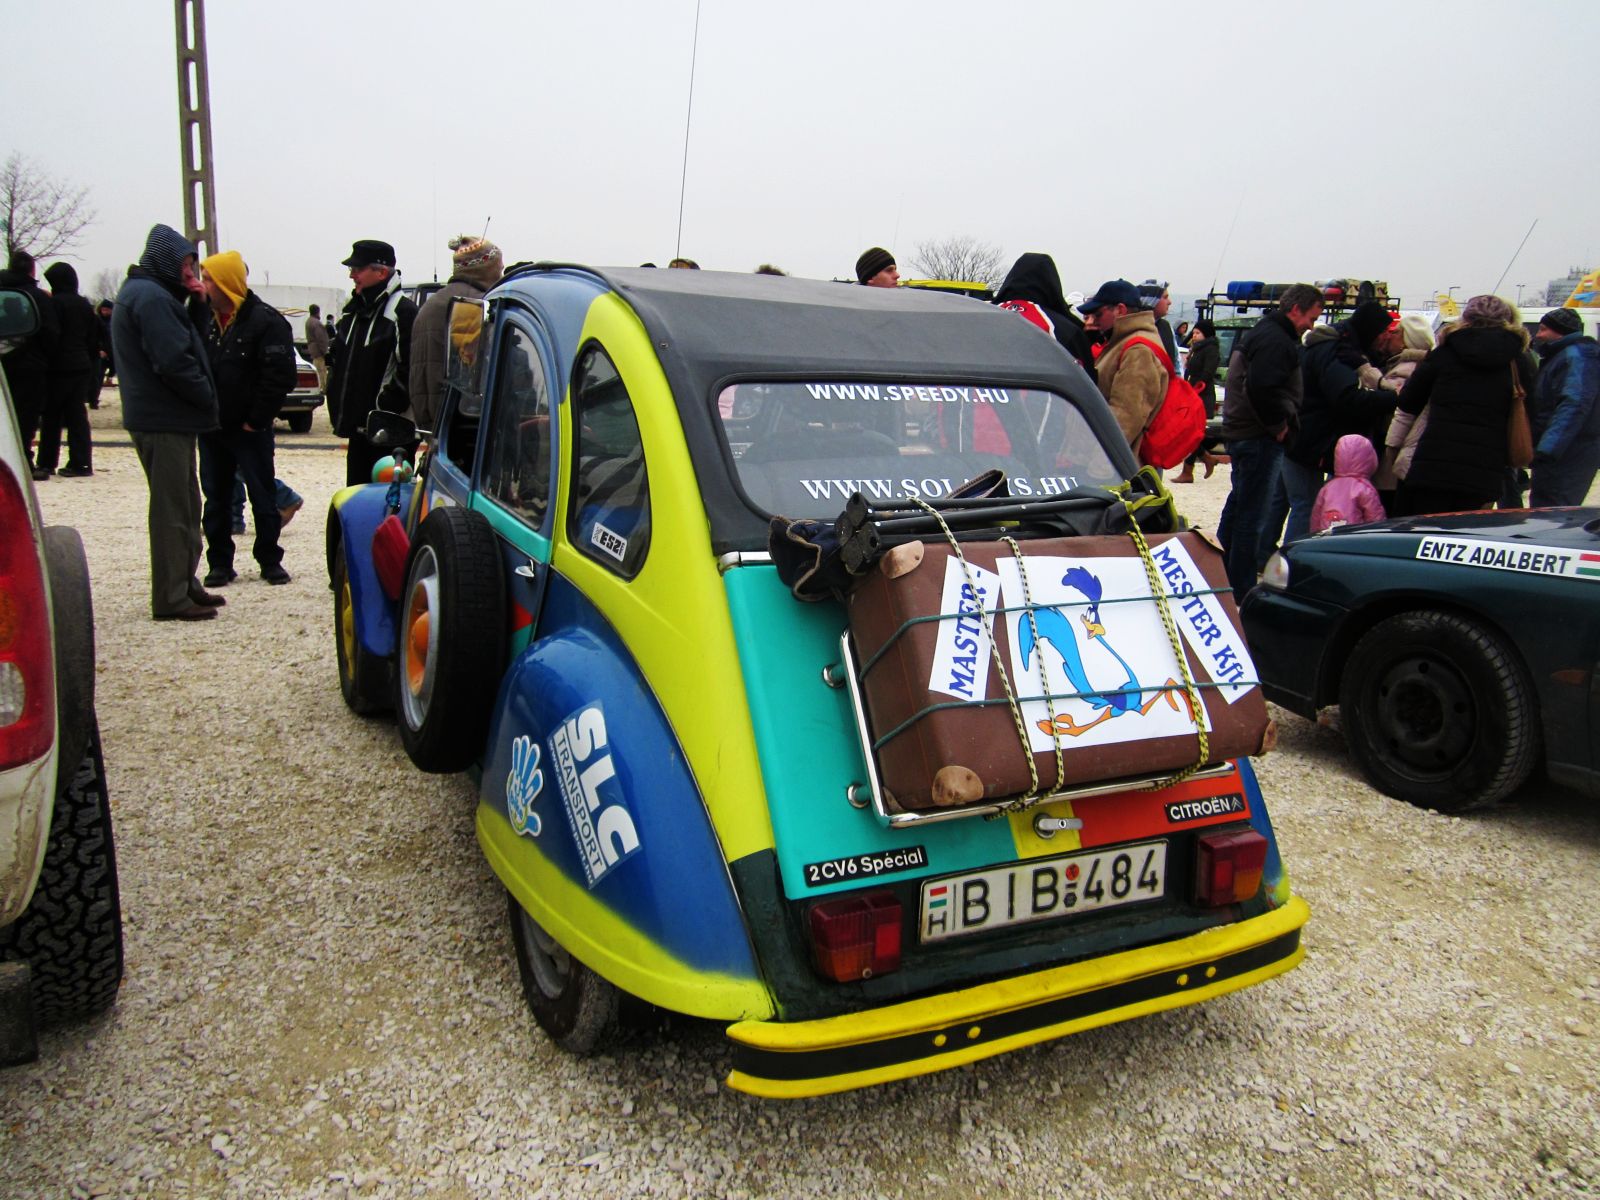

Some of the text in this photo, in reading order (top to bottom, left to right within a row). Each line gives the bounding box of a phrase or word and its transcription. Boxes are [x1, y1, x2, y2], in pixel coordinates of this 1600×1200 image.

[806, 383, 1009, 404] WWW.SPEEDY.HU
[1420, 541, 1571, 574] ENTZ ADALBERT
[1153, 546, 1222, 647] MESTER
[557, 733, 603, 867] TRANSPORT
[566, 707, 640, 867] SLC
[1170, 796, 1231, 820] CITROËN
[860, 848, 923, 874] Spécial
[927, 910, 947, 935] H
